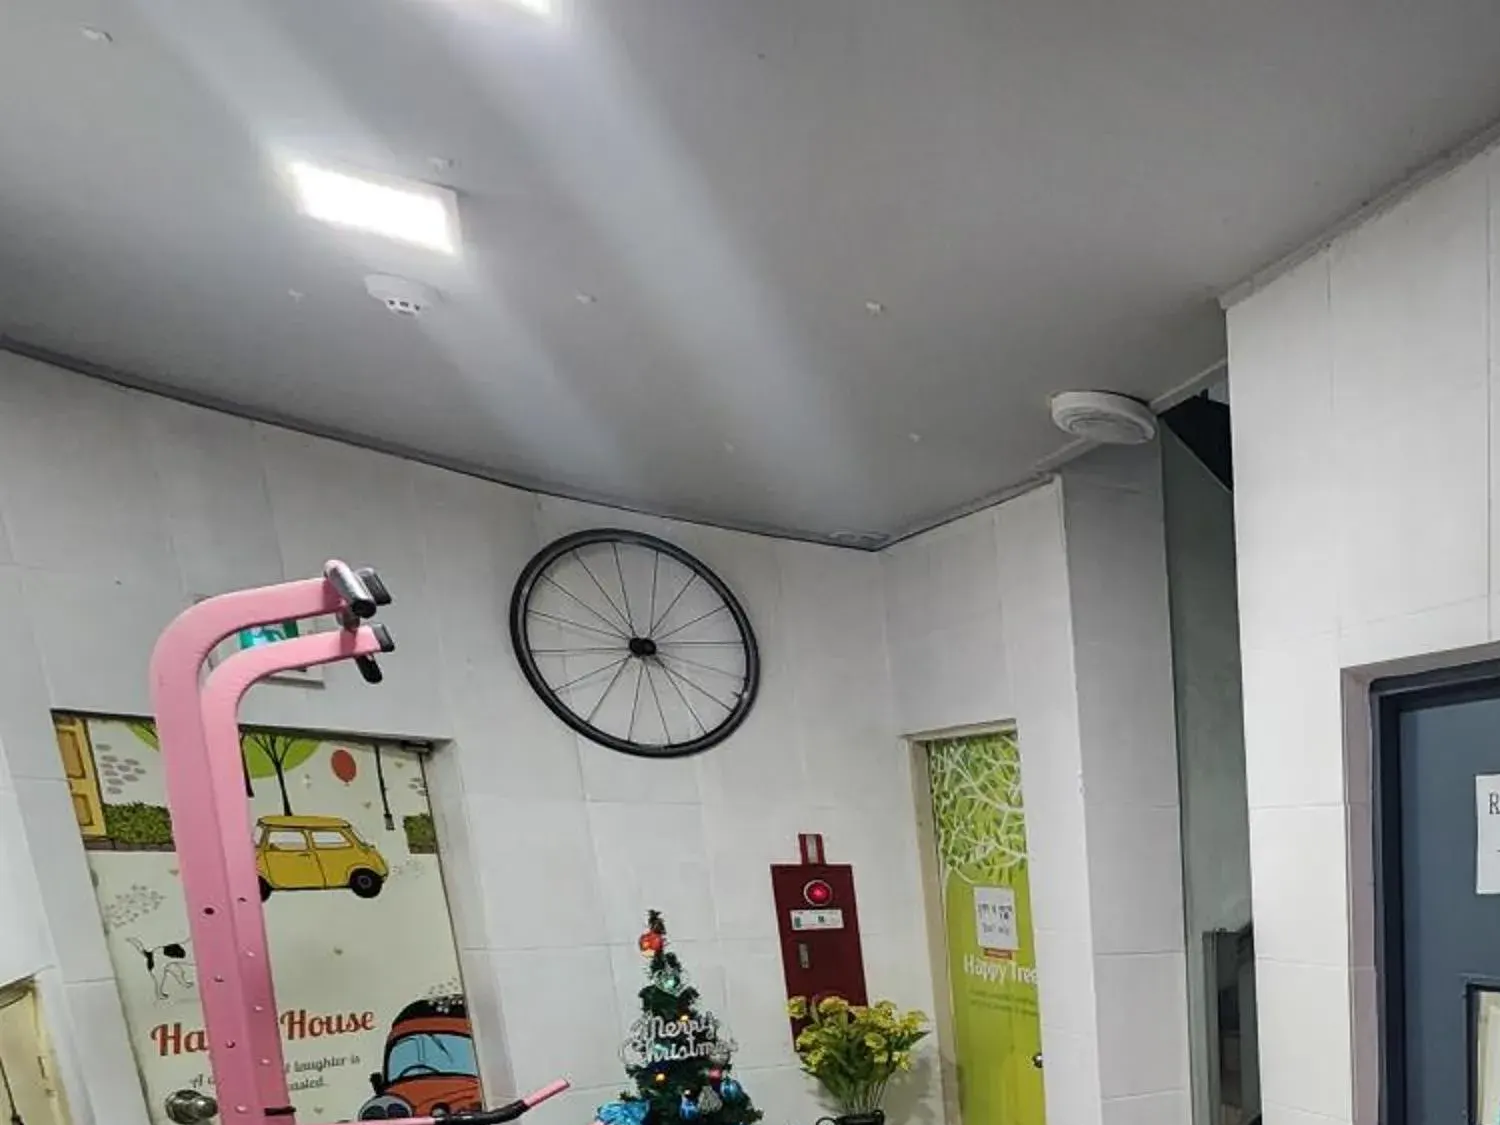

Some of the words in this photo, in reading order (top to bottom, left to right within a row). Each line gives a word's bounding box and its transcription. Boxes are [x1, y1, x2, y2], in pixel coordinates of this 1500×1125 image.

[963, 952, 1007, 984] Happy
[280, 1009, 376, 1040] House
[632, 1010, 716, 1039] Merry
